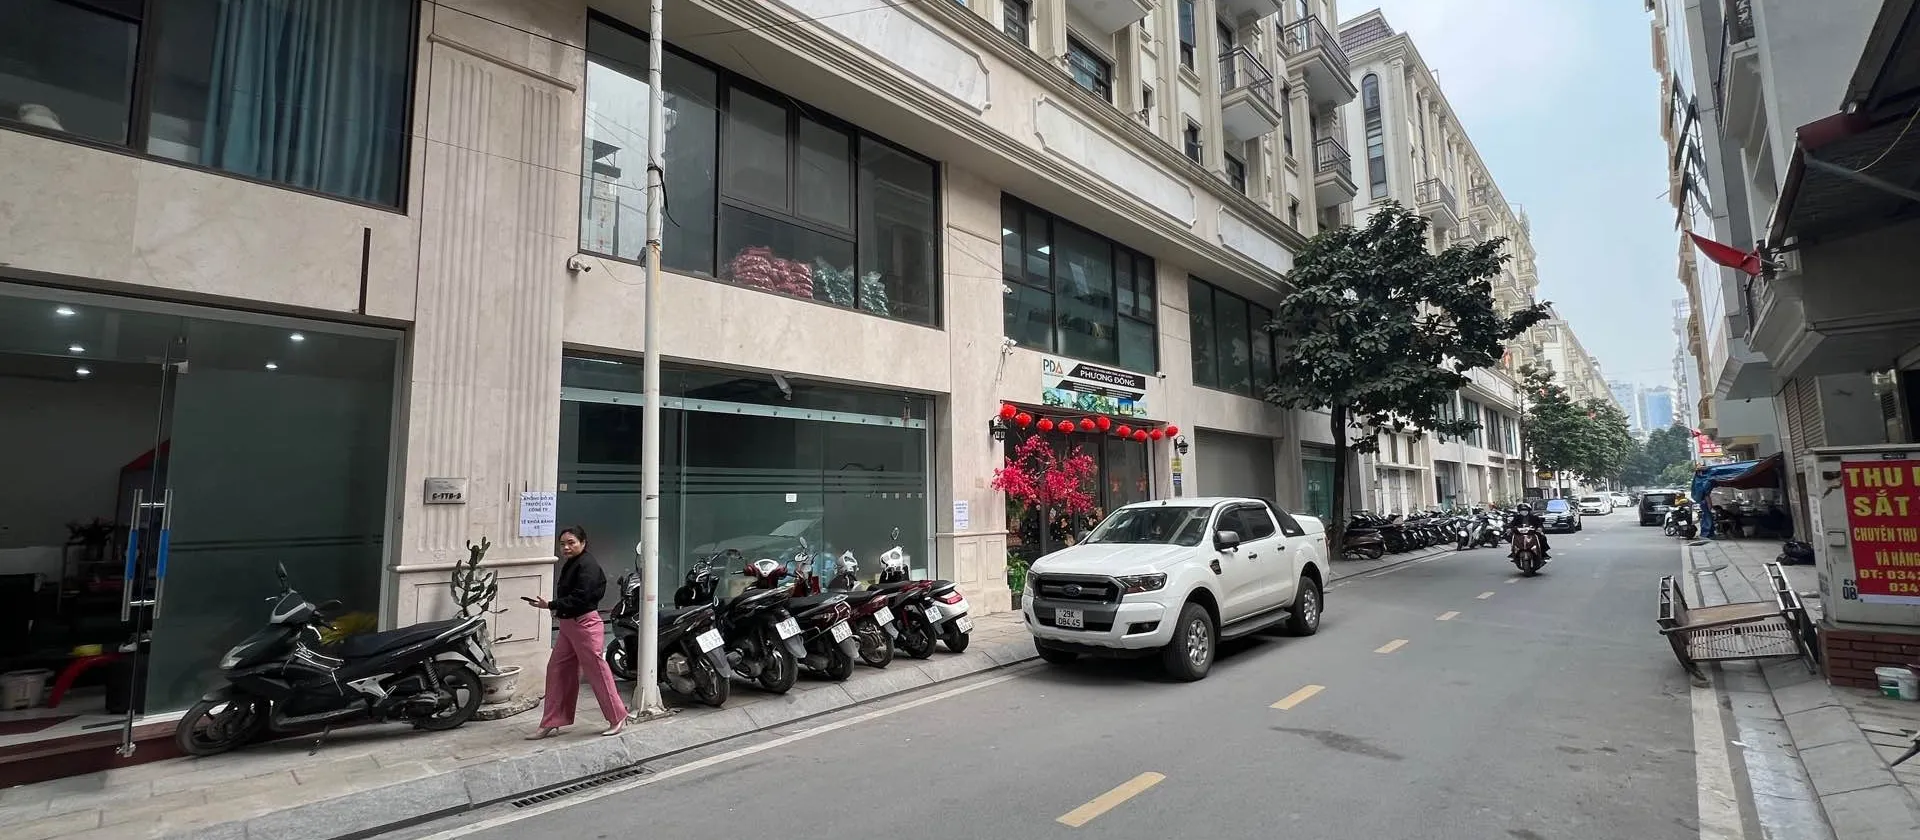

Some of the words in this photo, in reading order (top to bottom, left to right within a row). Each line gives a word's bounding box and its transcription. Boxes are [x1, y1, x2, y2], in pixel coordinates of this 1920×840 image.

[1043, 359, 1063, 374] PDA
[1845, 467, 1903, 488] THU
[1854, 489, 1910, 517] SẮT
[1854, 525, 1896, 543] CHUYÊN
[1896, 527, 1918, 543] THU
[1875, 549, 1890, 566] VÀ
[1859, 569, 1884, 580] ĐT:
[1889, 582, 1920, 594] 034
